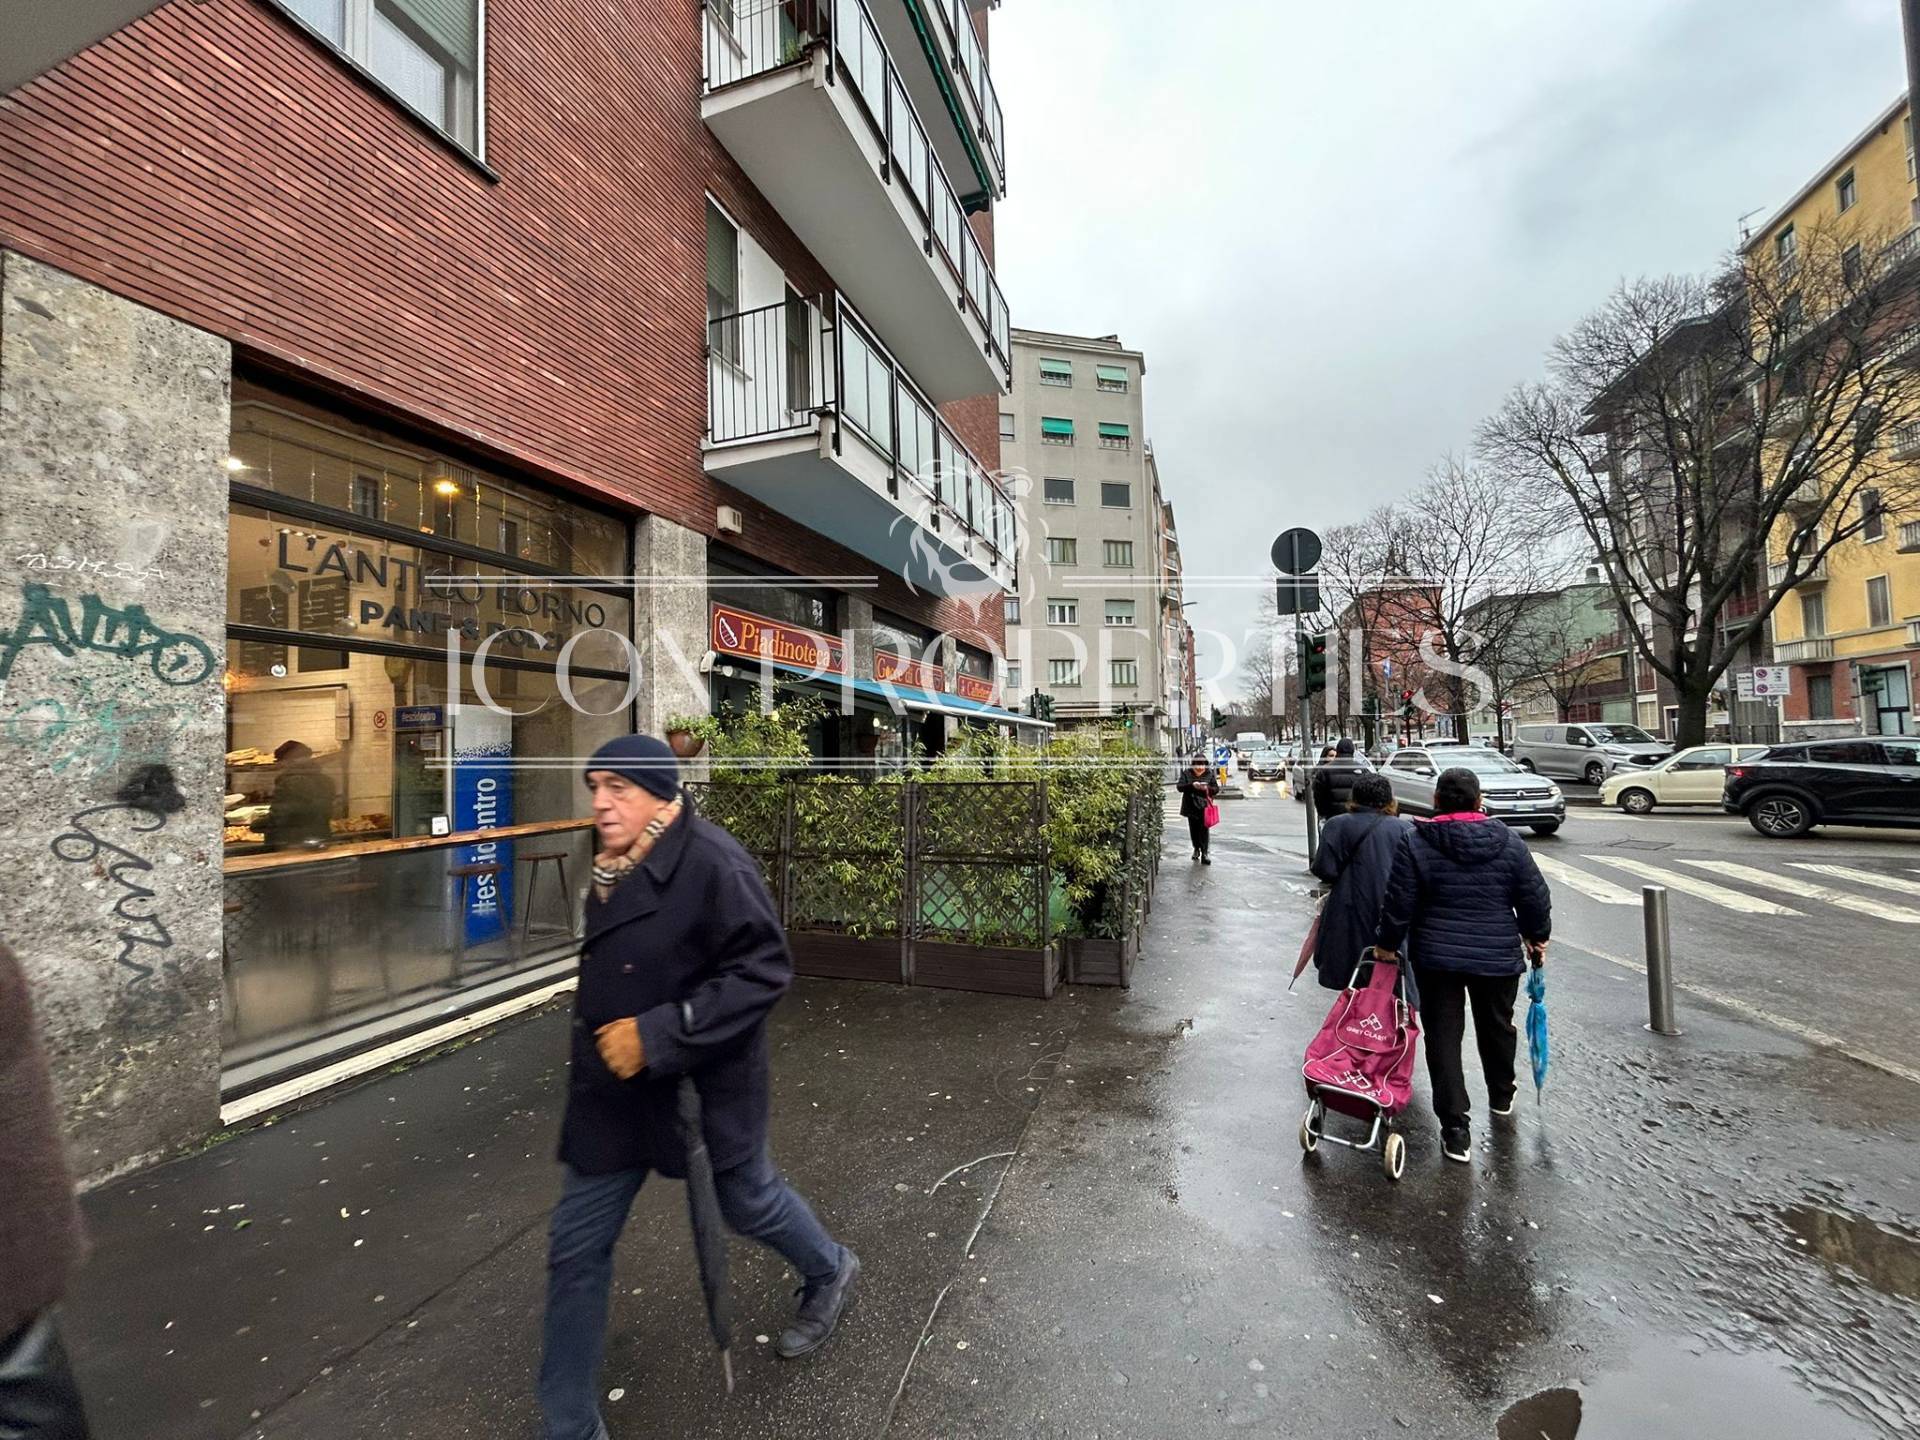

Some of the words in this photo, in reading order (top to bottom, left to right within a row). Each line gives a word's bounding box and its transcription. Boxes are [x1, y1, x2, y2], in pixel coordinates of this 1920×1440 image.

[279, 532, 483, 605] L'ANTICO
[497, 576, 605, 628] FORNO
[361, 599, 451, 635] PANE
[460, 617, 480, 641] &
[738, 621, 830, 667] Piadinoteca
